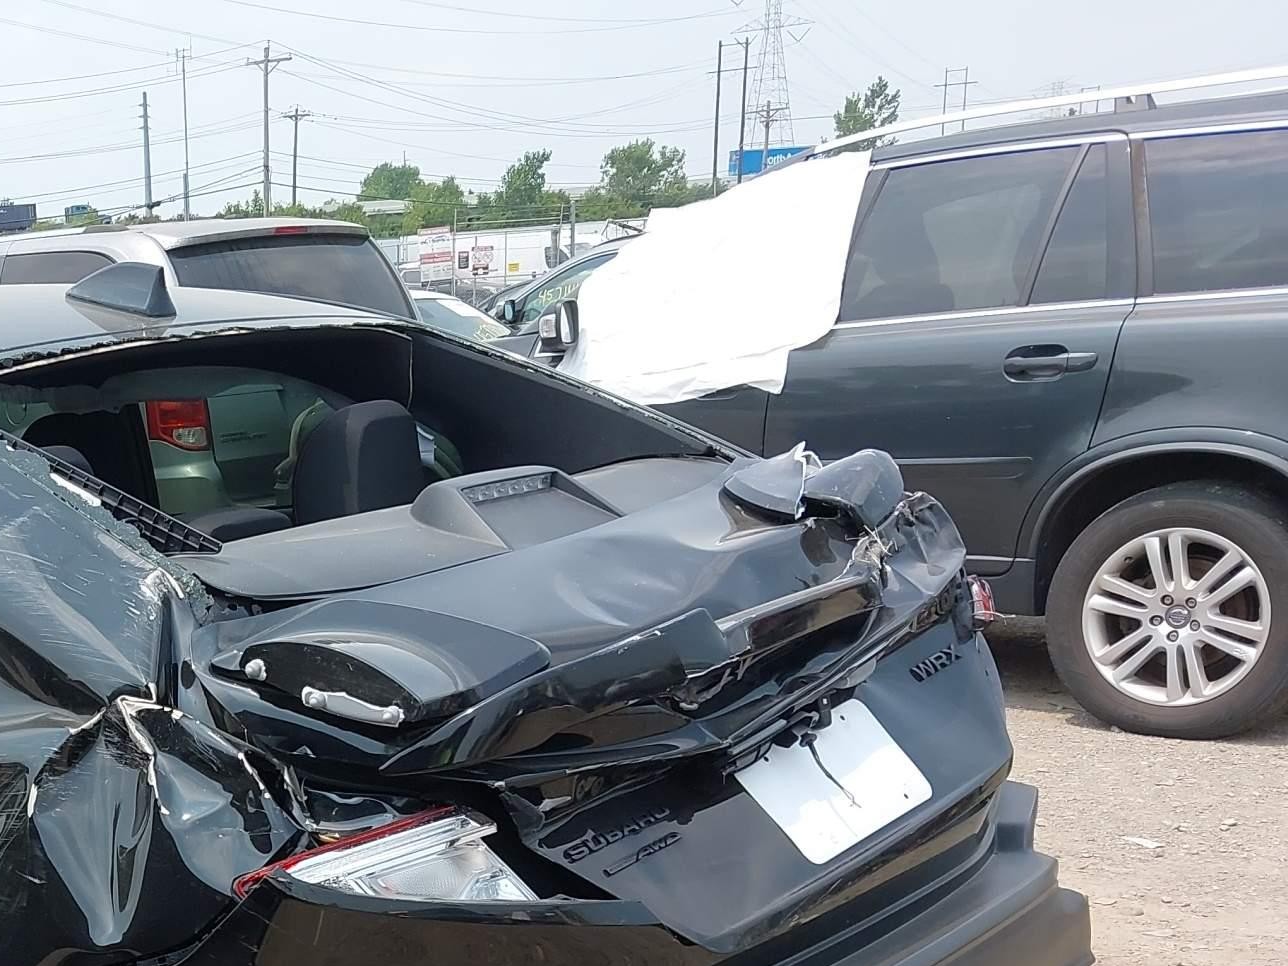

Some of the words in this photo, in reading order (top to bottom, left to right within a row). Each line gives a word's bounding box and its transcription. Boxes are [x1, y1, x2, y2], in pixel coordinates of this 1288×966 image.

[909, 643, 962, 682] WRX
[562, 806, 672, 864] SUBARU
[636, 831, 682, 862] AWD
